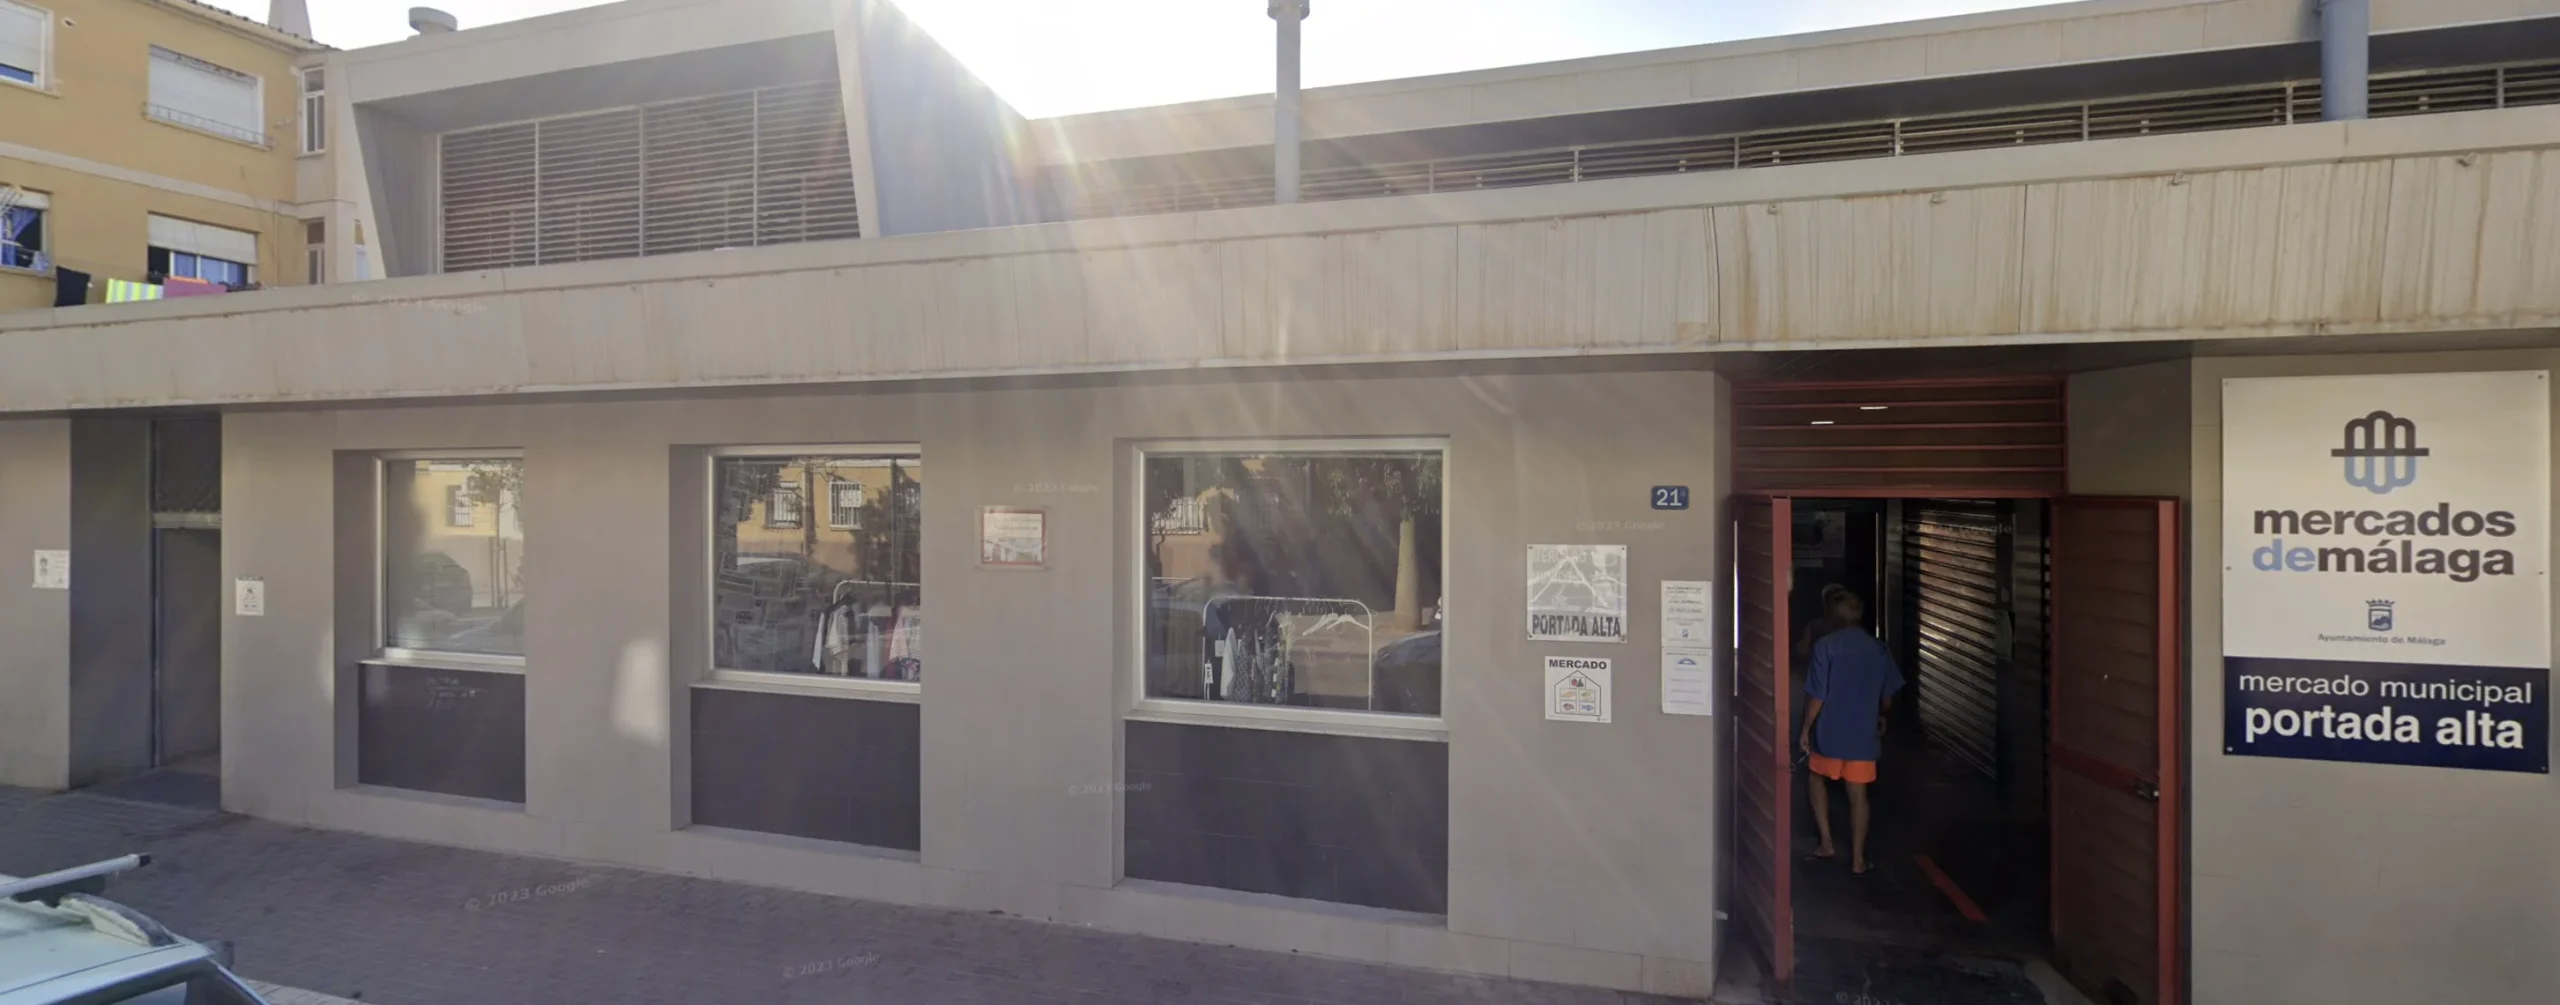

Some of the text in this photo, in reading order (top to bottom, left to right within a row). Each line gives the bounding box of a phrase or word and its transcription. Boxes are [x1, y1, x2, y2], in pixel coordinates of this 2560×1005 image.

[1656, 488, 1683, 506] 21
[2254, 502, 2517, 537] mercados
[2252, 538, 2515, 583] demálaga
[1532, 614, 1621, 637] PORTADA ALTA
[2318, 633, 2446, 647] Ayuntamiento de Málaga
[1549, 659, 1607, 670] MERCADO
[2239, 674, 2532, 707] mercado municipal
[2246, 705, 2524, 749] portada alta
